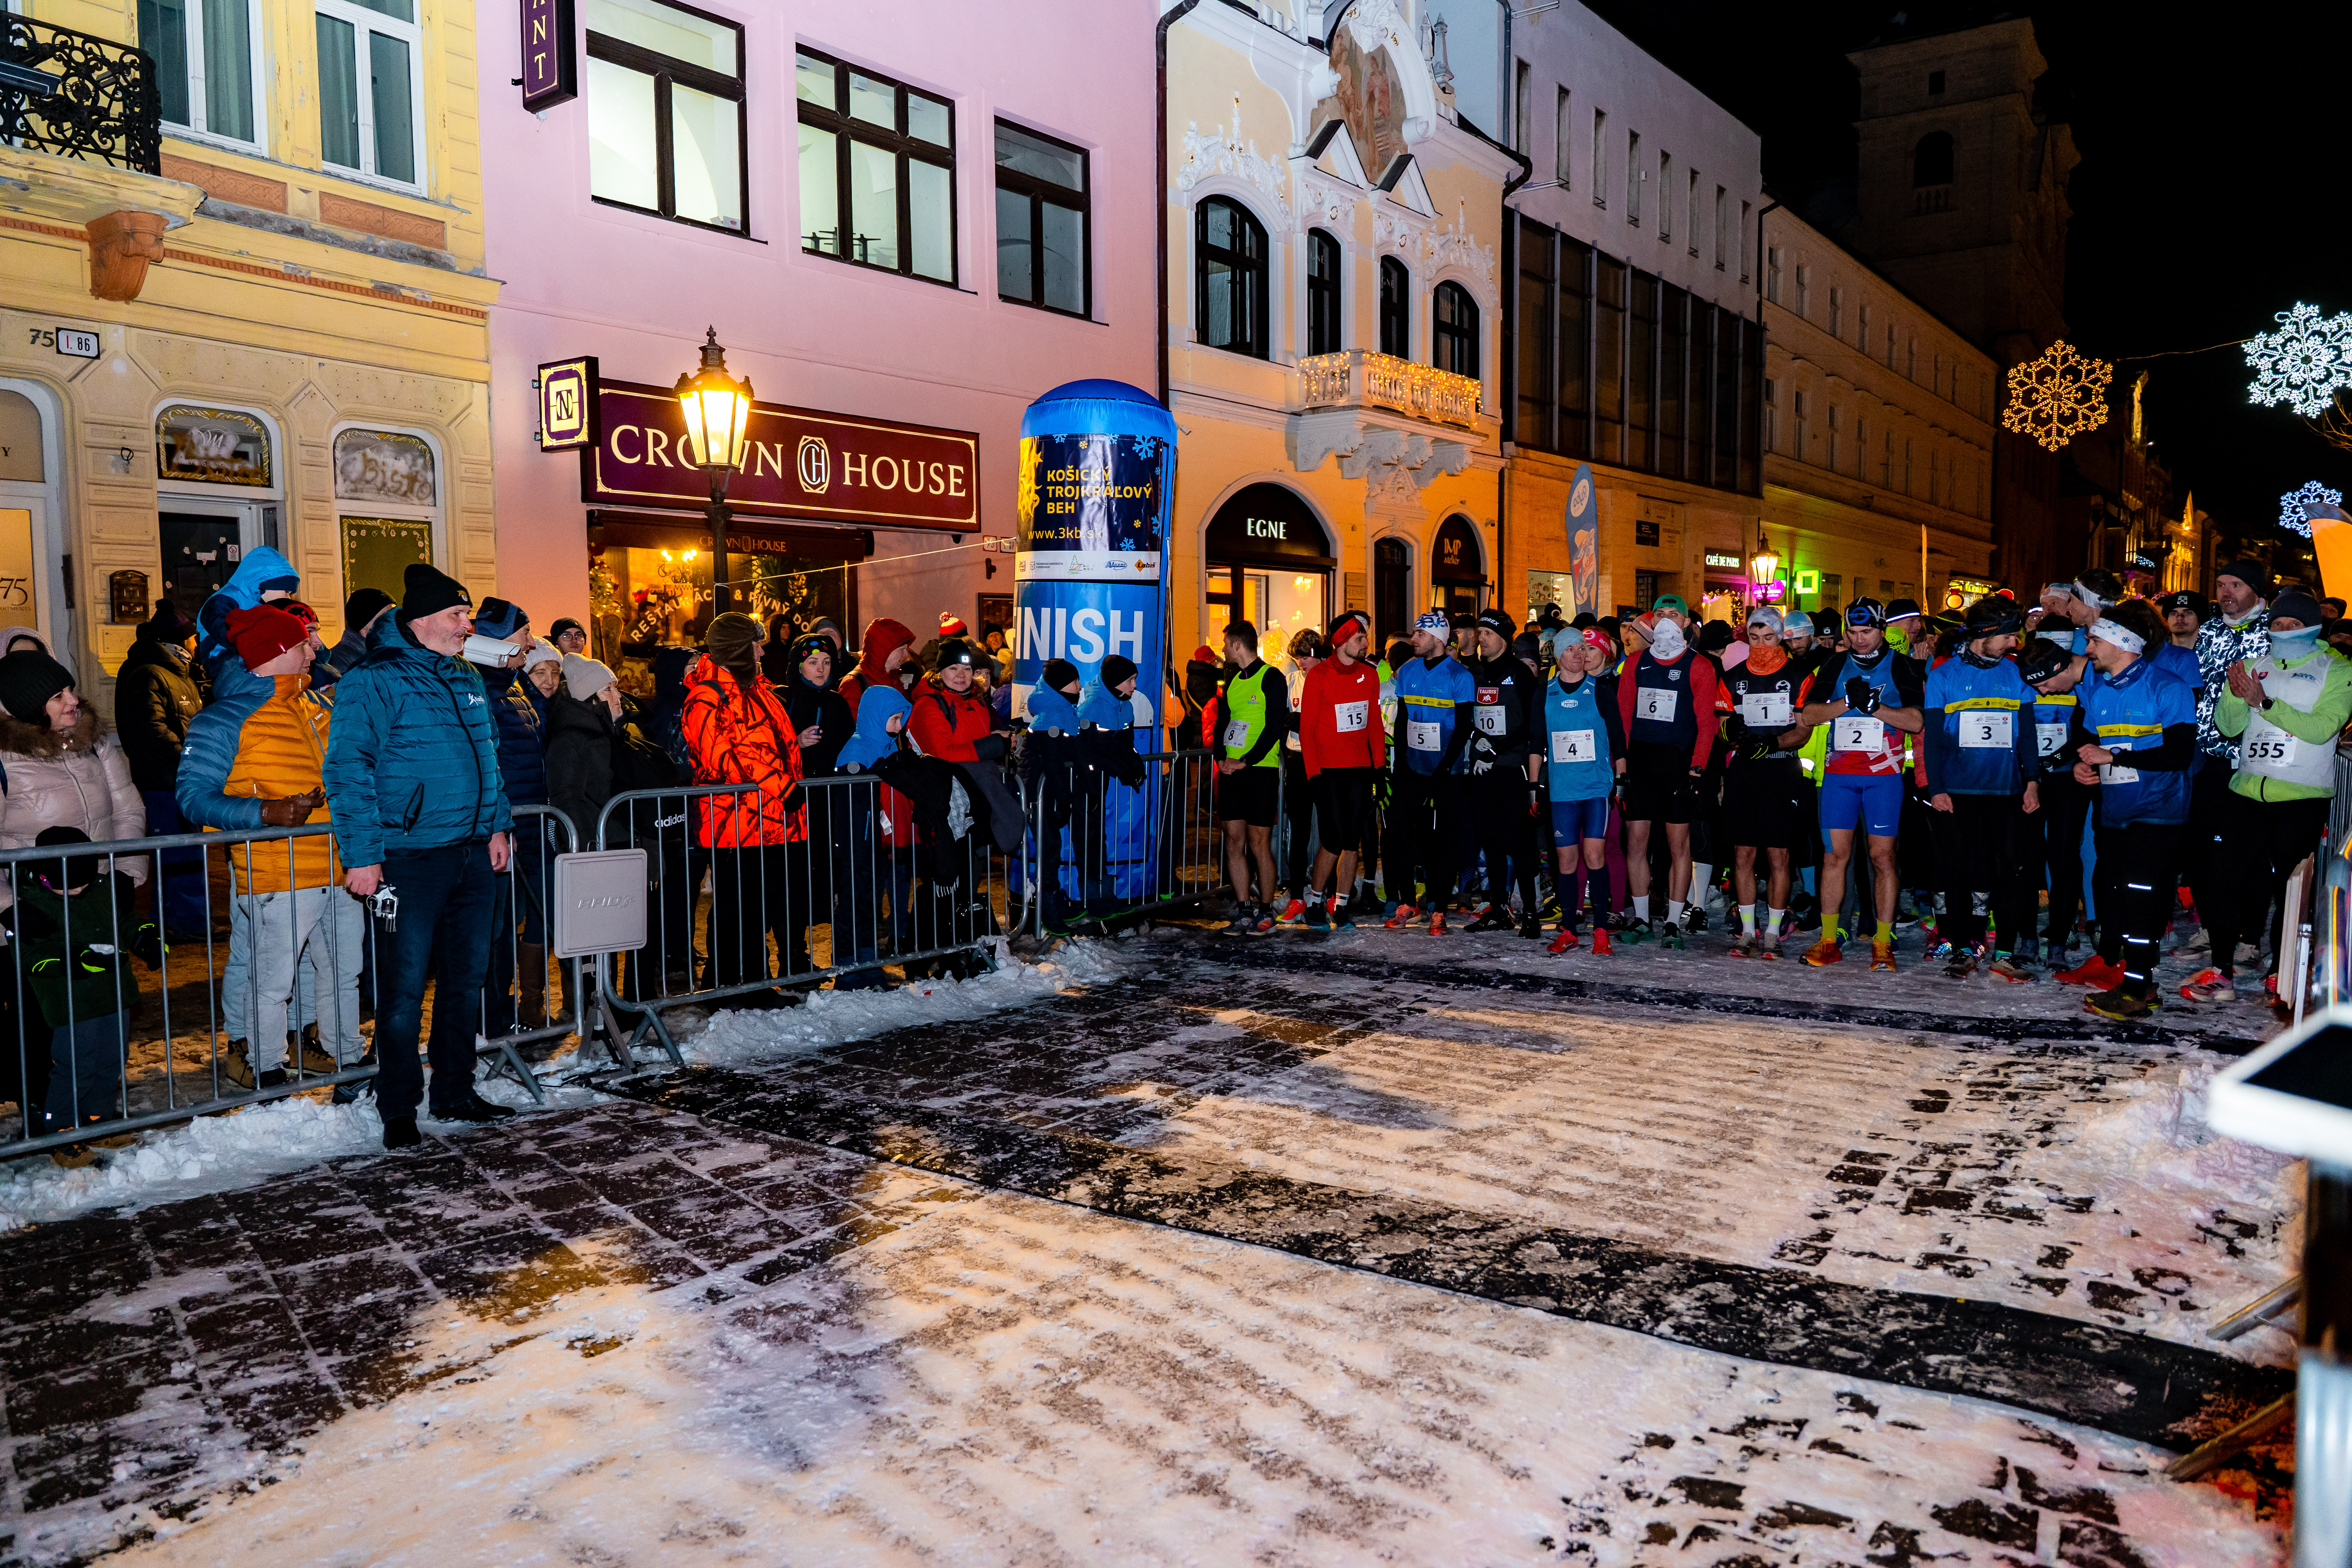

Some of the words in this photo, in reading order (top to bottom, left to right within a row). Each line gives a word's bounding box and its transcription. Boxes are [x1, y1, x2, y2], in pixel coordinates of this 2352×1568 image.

[29, 328, 55, 347] 75
[77, 337, 90, 352] 86
[611, 424, 784, 479] CRN
[842, 452, 966, 497] HOUSE
[1047, 466, 1112, 481] KOŠICKÝ
[1047, 483, 1152, 499] TROJKRÁĽOVÝ
[1047, 503, 1075, 514] BEH
[1027, 527, 1102, 540] www.3kb.sk
[1247, 518, 1287, 539] EGNE
[753, 539, 787, 552] HOUSE
[1706, 553, 1719, 566] CAFÉ
[1719, 556, 1726, 566] DE
[1726, 557, 1740, 568] PARIS
[734, 589, 742, 601] &
[749, 592, 790, 615] PIVNÝ
[793, 613, 810, 632] DO
[1479, 617, 1500, 626] TERREX
[2026, 671, 2045, 680] ATU
[1649, 701, 1657, 713] 6
[1761, 706, 1768, 719] 1
[1347, 712, 1362, 725] 15
[1480, 717, 1494, 730] 10
[1228, 730, 1234, 740] 8
[1417, 733, 1425, 745] 5
[1852, 730, 1862, 744] 2
[1981, 726, 1992, 740] 3
[1568, 743, 1578, 756] 4
[2042, 737, 2053, 751] 2
[2248, 742, 2285, 759] 555
[654, 813, 685, 828] adidas
